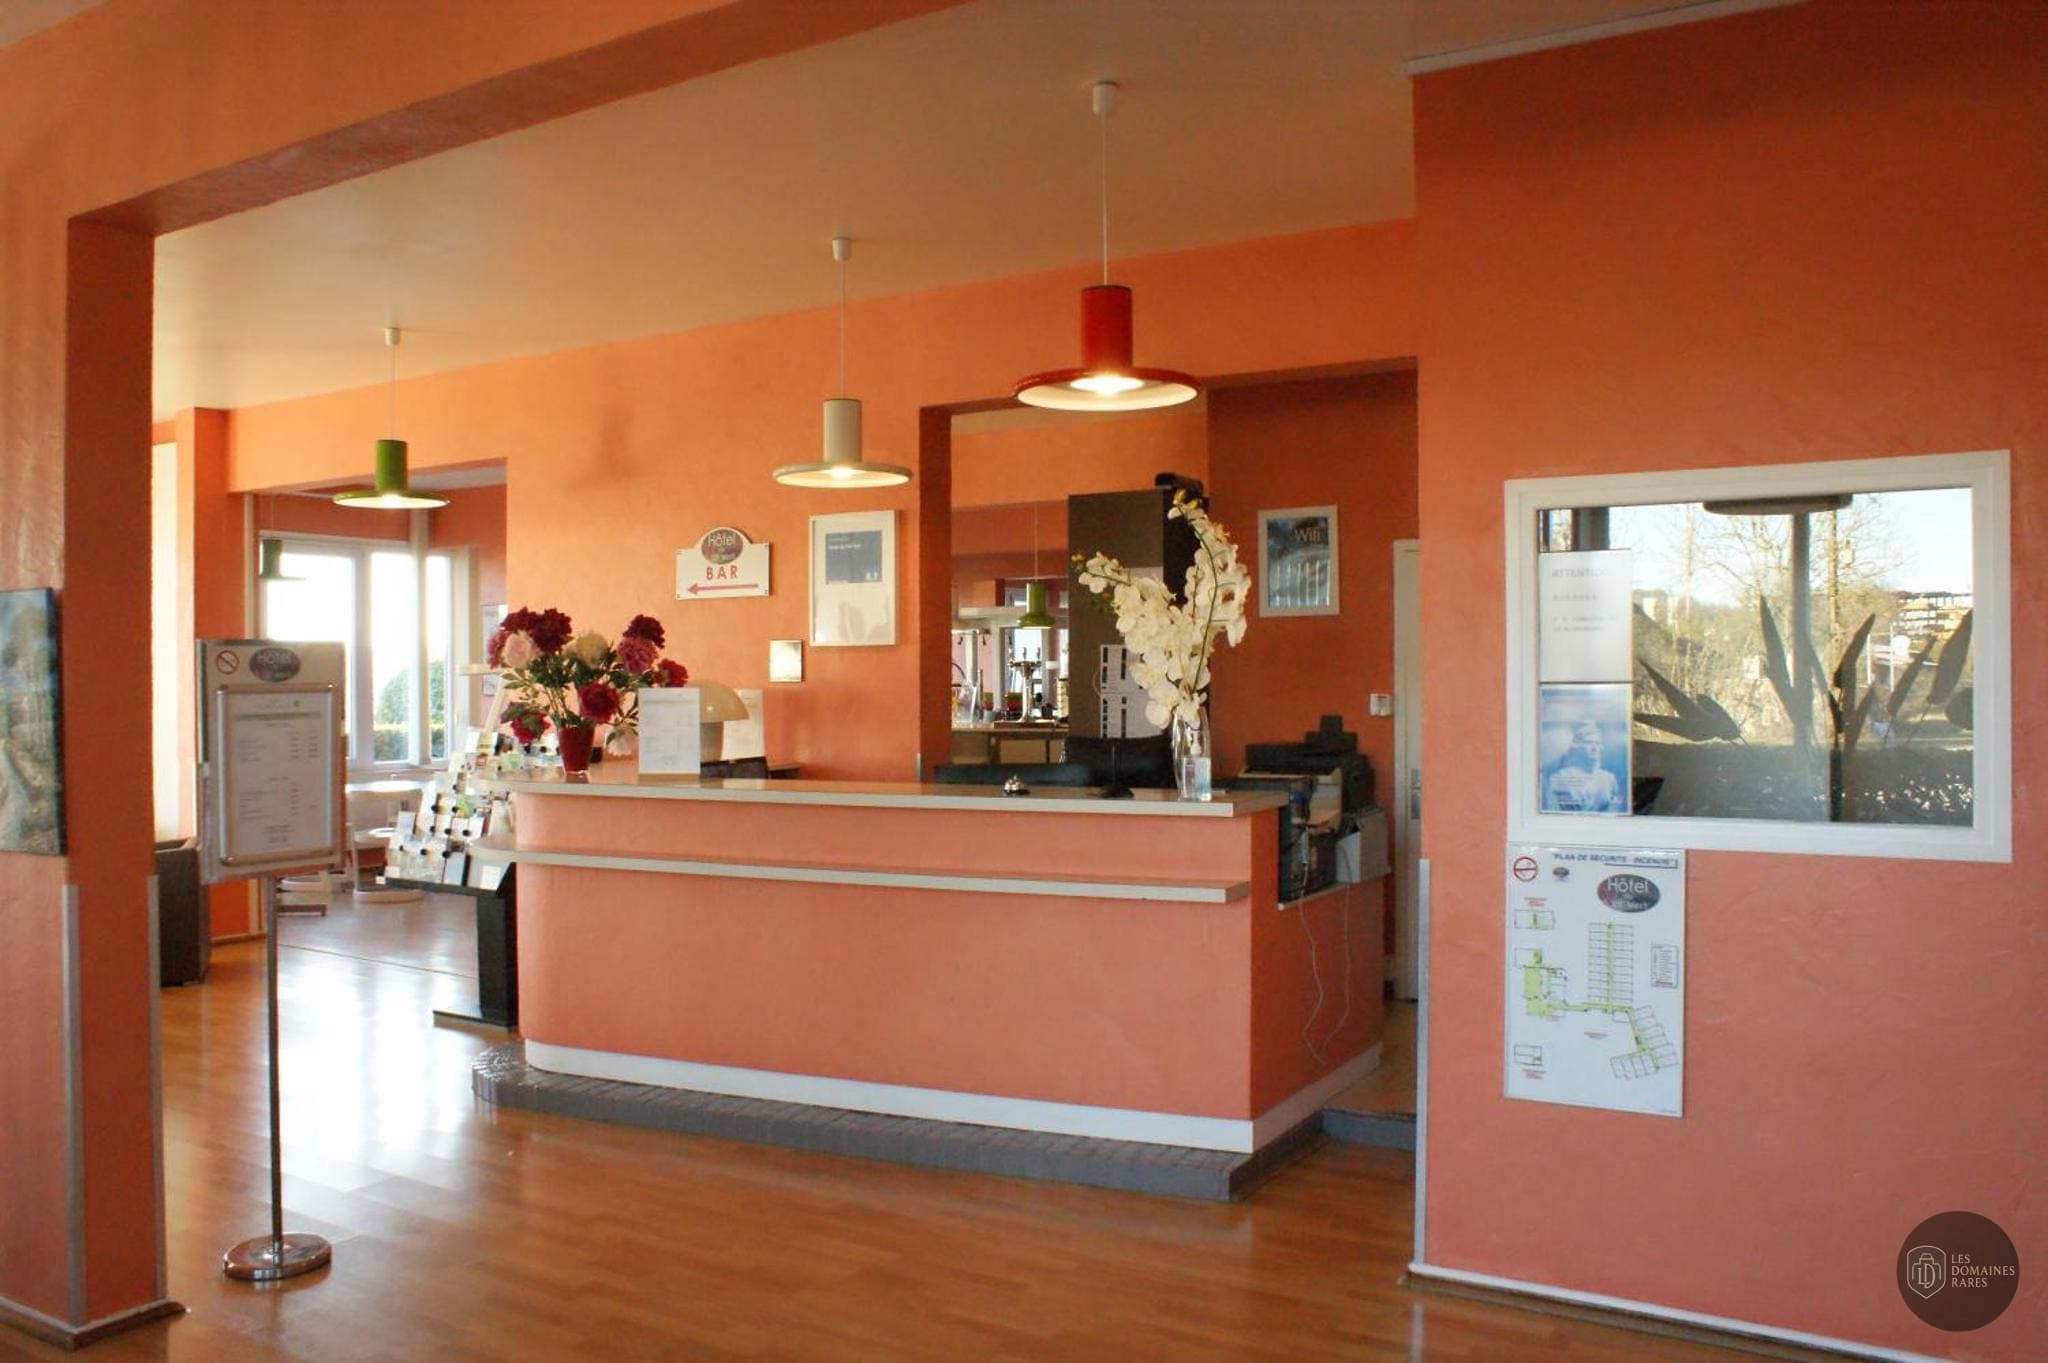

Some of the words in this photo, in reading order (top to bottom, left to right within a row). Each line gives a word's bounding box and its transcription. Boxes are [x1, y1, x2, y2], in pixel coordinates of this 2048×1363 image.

[707, 533, 737, 547] Hôtel
[706, 564, 738, 581] BAR
[1607, 876, 1648, 894] Hôtel
